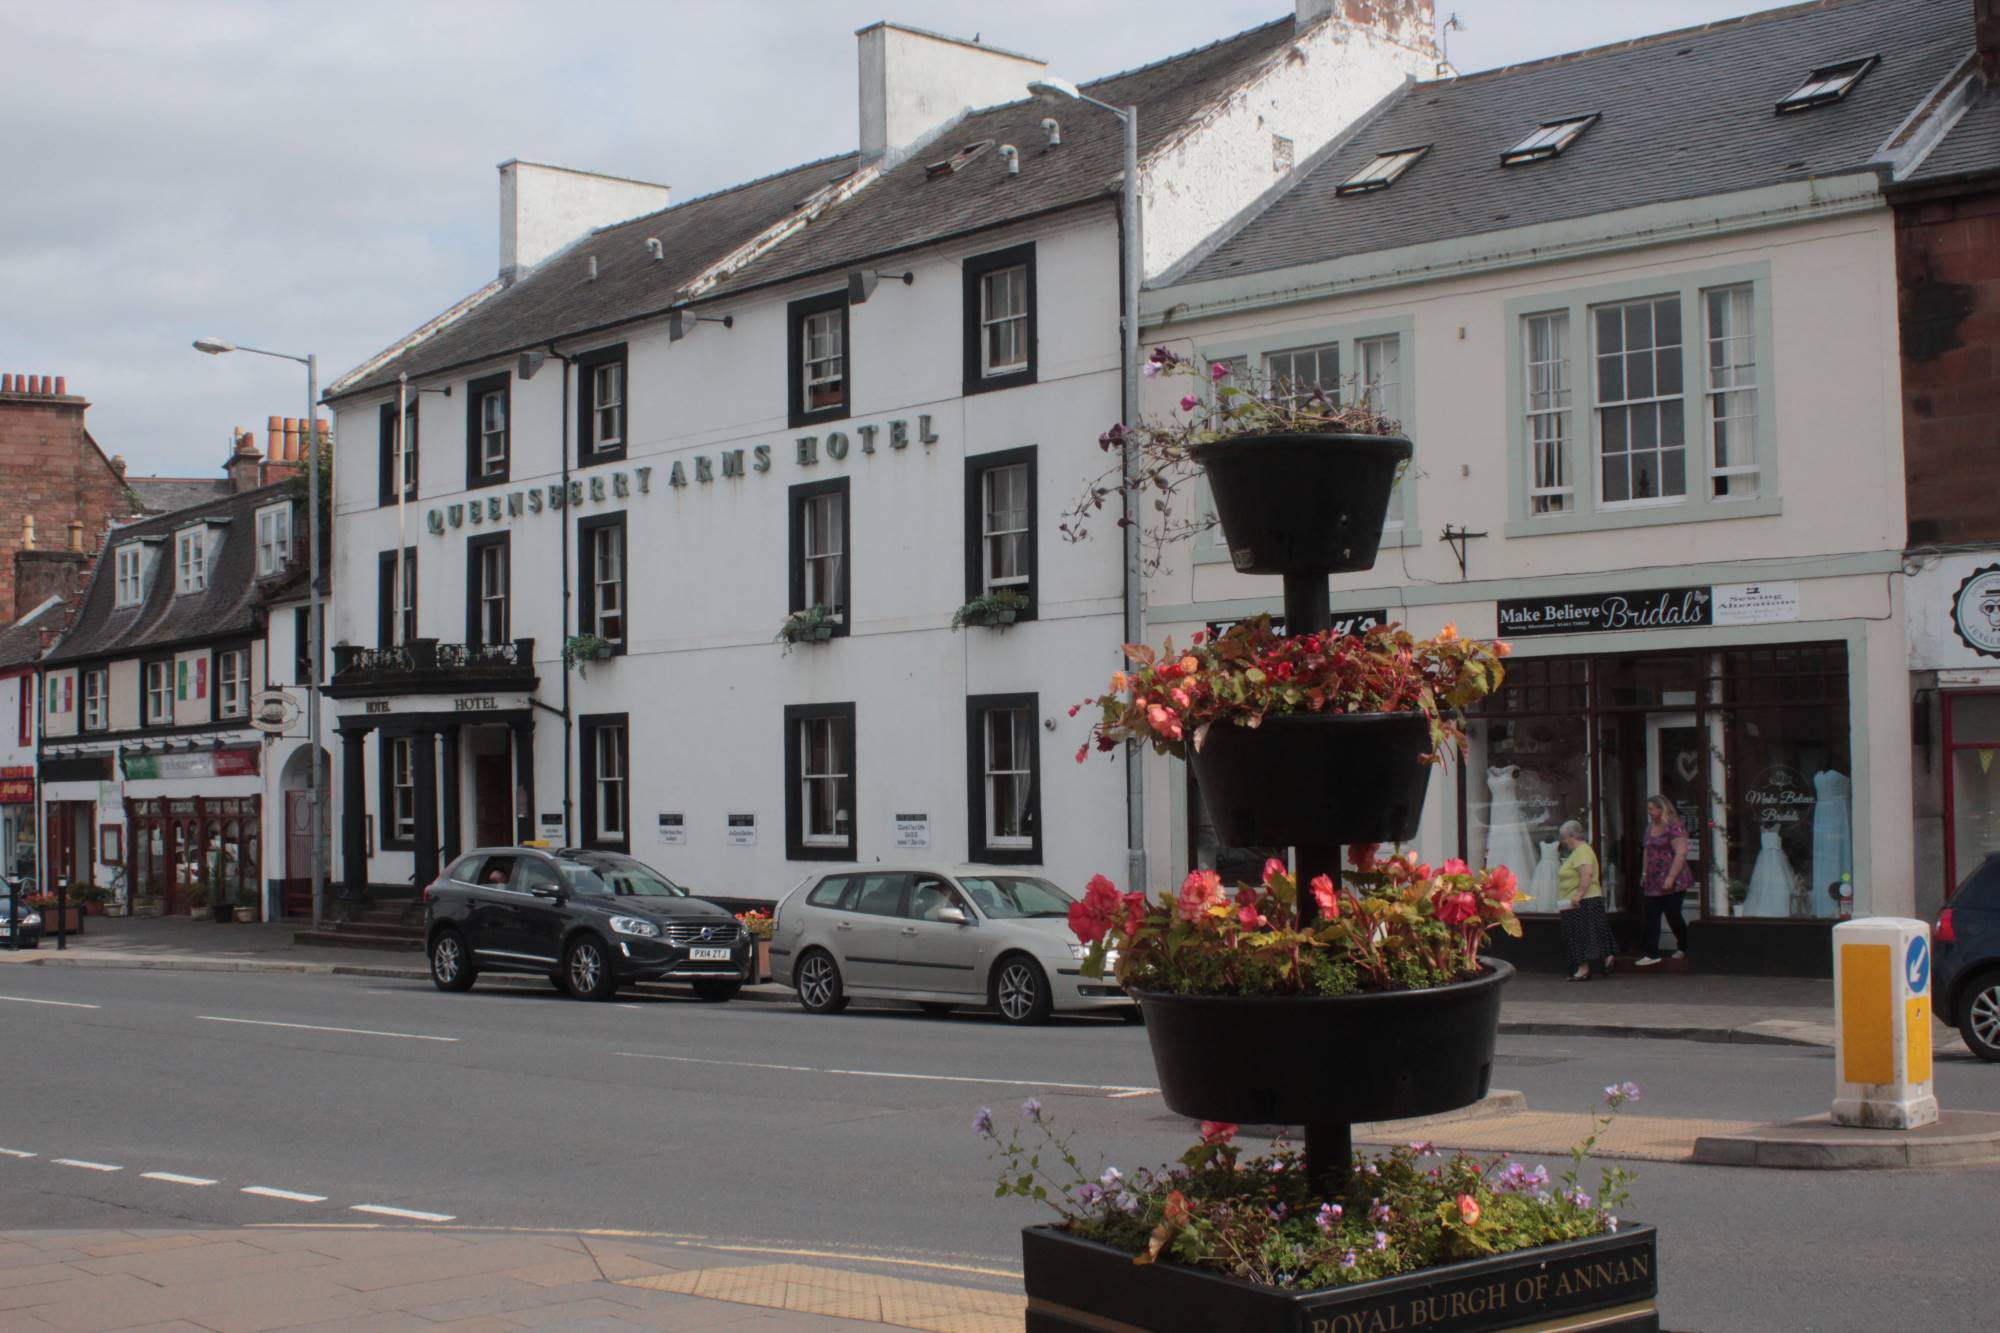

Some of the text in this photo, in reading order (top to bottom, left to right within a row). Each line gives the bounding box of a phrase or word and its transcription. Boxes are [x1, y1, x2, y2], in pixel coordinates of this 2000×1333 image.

[427, 414, 939, 536] QUEENSBERRY ARMS HOTEL
[1500, 607, 1540, 623] Make
[1544, 604, 1600, 620] Believe
[1602, 591, 1703, 628] Bridals
[366, 702, 390, 713] HOTEL
[455, 698, 498, 711] HOTEL
[1745, 791, 1817, 804] Make Believe
[1761, 808, 1800, 821] Bridals
[1411, 1284, 1506, 1326] BURGH
[1514, 1274, 1549, 1304] OF
[1555, 1254, 1649, 1296] ANNAN
